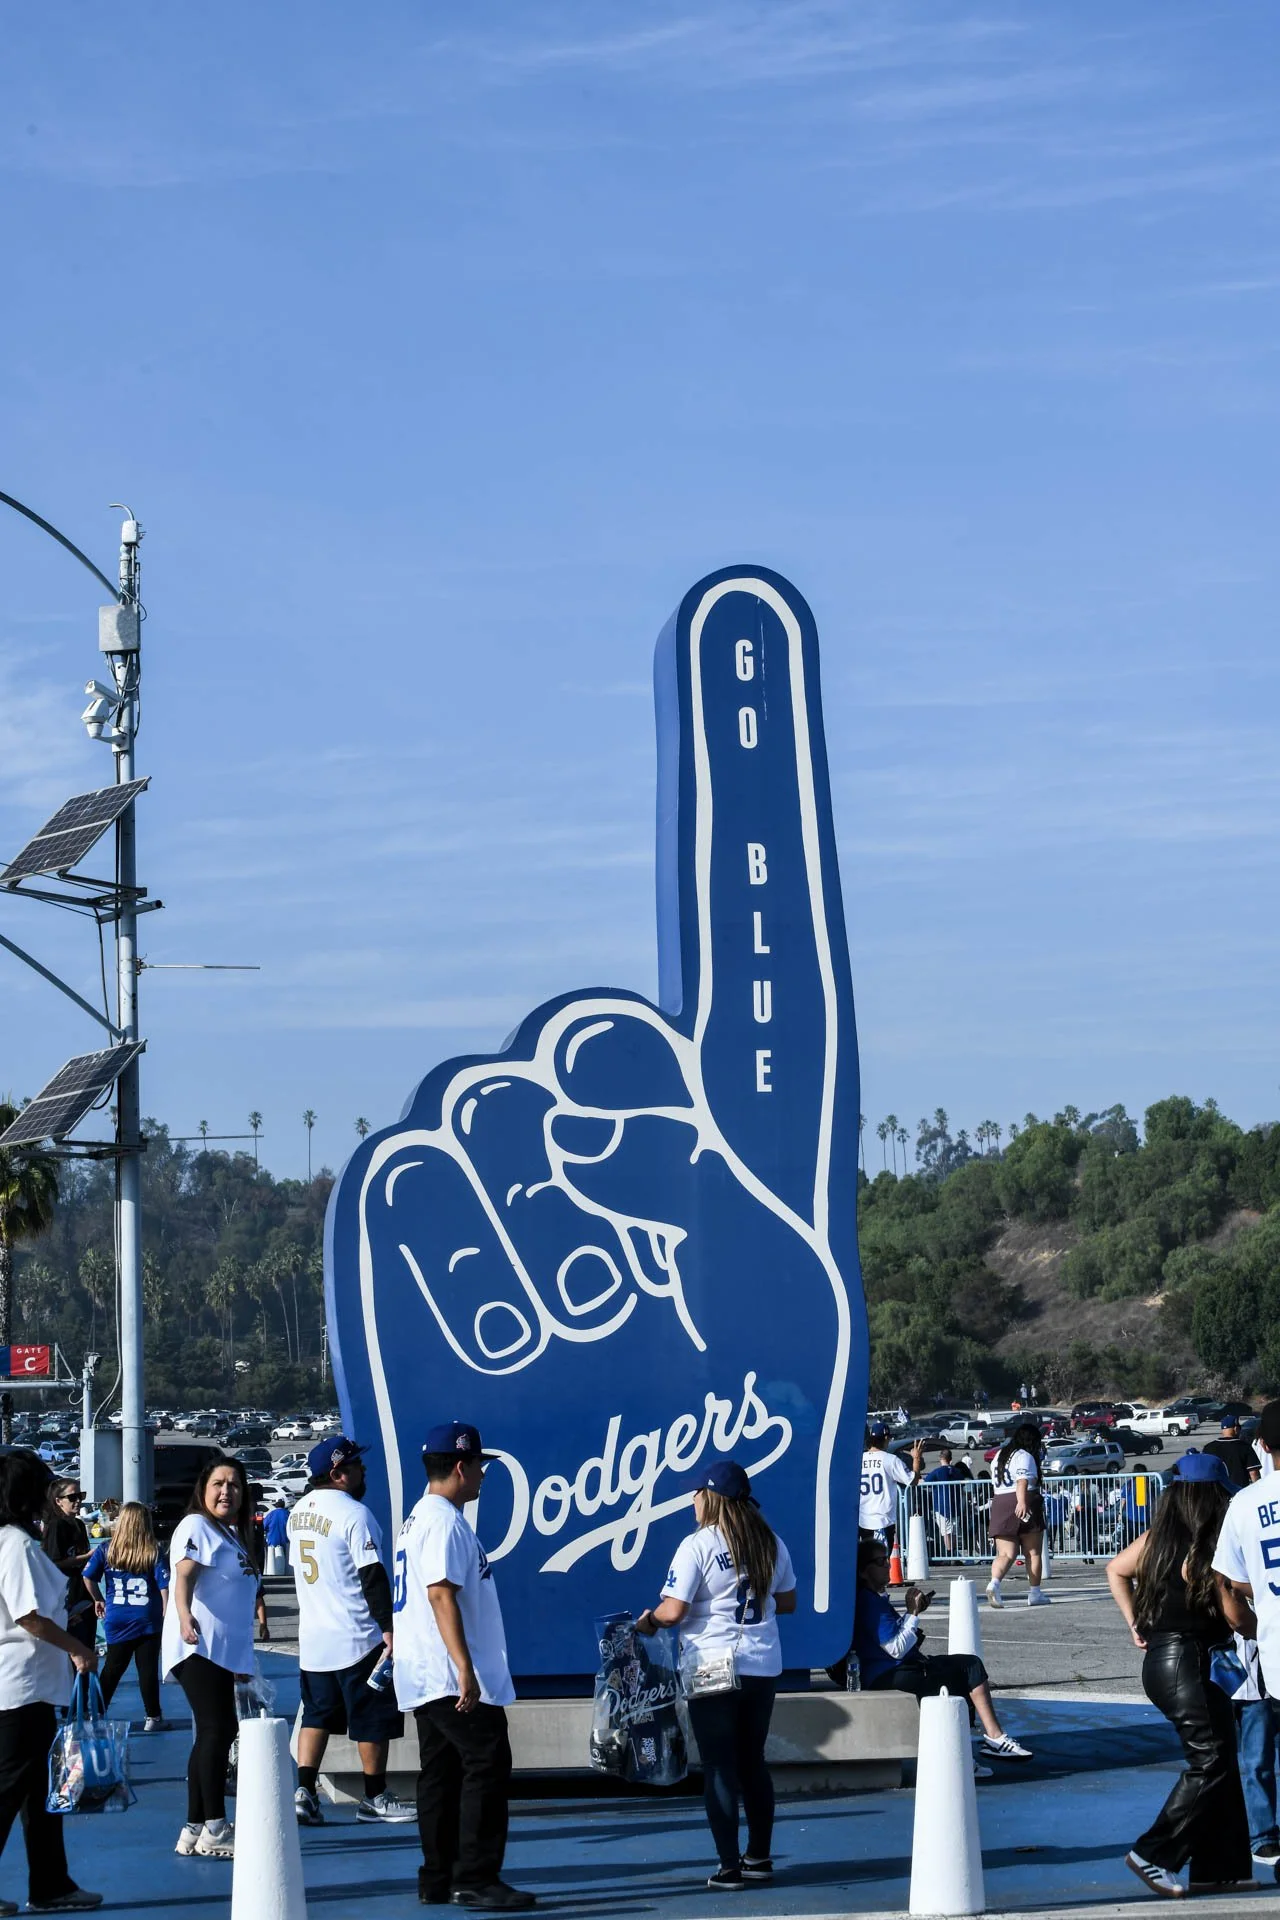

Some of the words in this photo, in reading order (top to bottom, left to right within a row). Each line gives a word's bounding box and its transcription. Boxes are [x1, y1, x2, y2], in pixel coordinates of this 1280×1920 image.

[735, 639, 758, 749] GO
[747, 843, 772, 1092] BLUE
[24, 1356, 36, 1371] C
[424, 1371, 793, 1572] Dodgers
[863, 1459, 881, 1469] ETTS
[860, 1472, 884, 1496] 50
[299, 1539, 320, 1585] 5
[112, 1577, 149, 1606] 13
[605, 1679, 677, 1725] Dodgers
